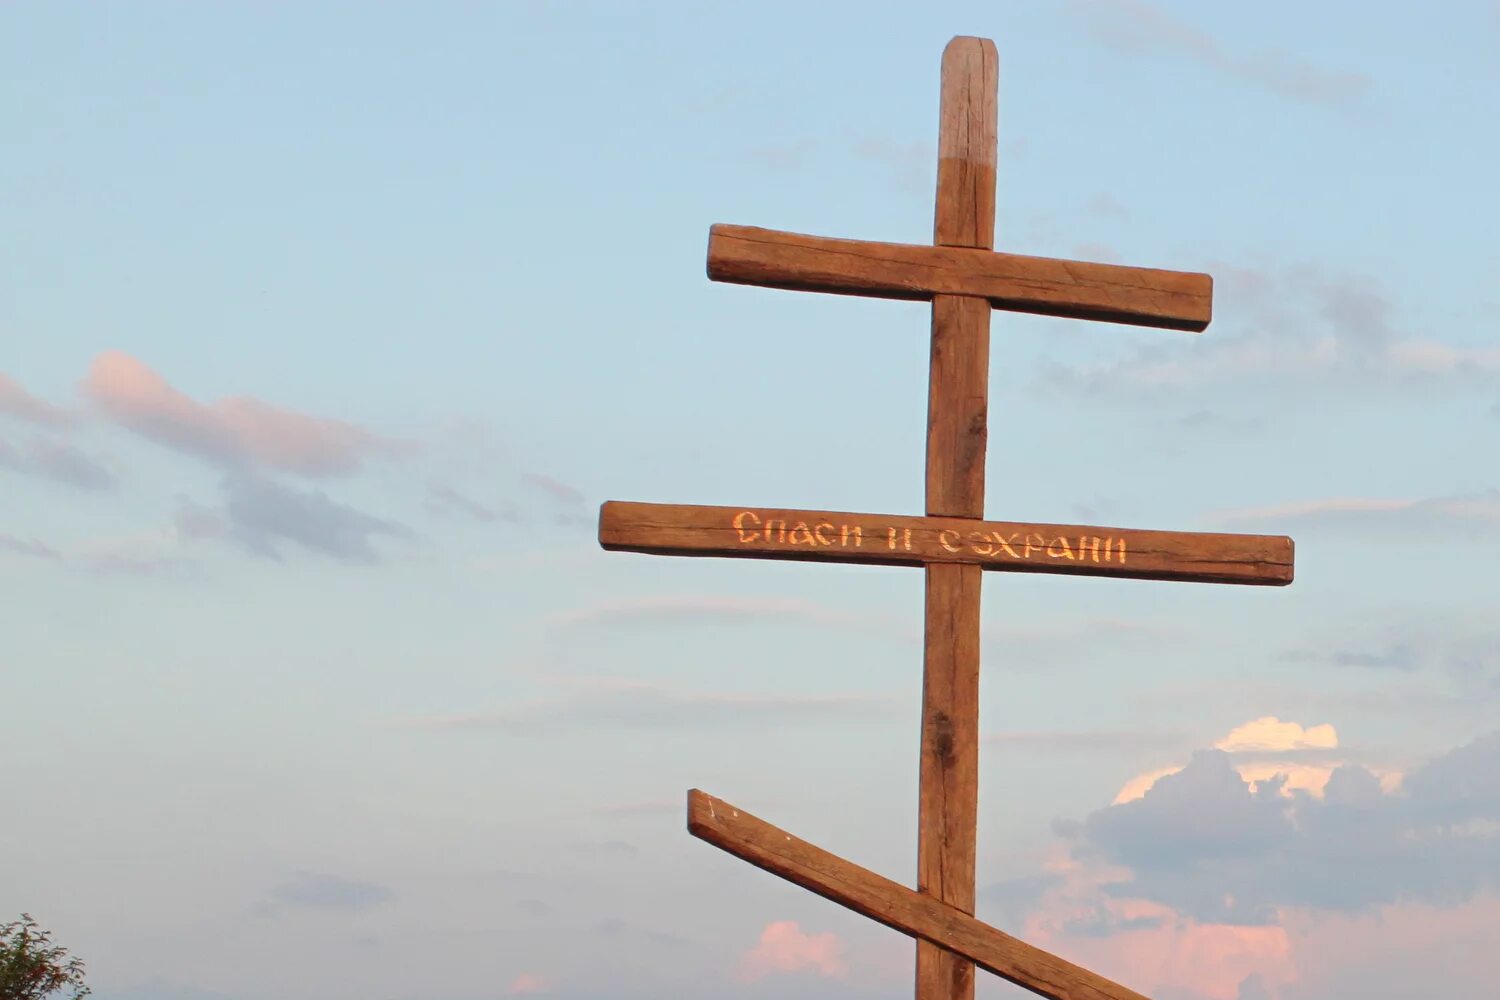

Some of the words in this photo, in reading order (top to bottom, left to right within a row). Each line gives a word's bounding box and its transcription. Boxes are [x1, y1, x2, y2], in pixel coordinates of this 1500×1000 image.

[733, 512, 861, 547] Спаси
[888, 527, 911, 551] и
[940, 529, 1126, 563] сохрани
